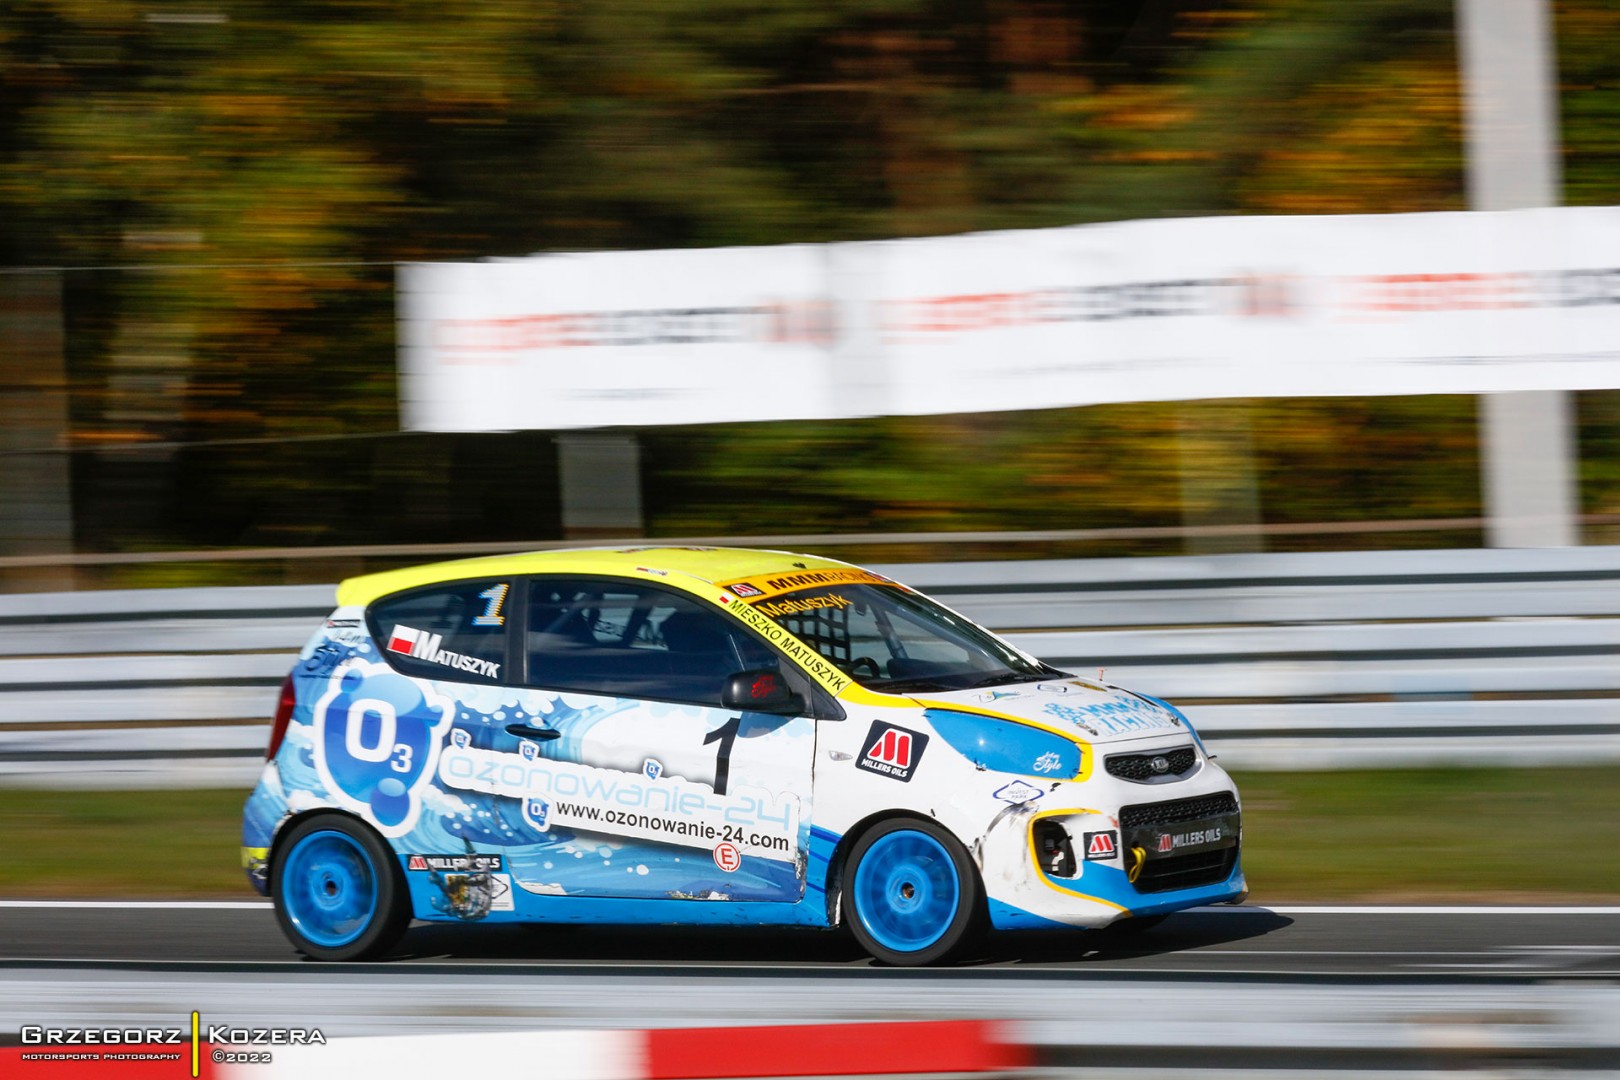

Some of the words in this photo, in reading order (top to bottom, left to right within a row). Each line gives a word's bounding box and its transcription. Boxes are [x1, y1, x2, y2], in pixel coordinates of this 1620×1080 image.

[471, 583, 510, 626] 1
[755, 592, 854, 618] Matuszyk
[728, 599, 782, 640] MIESZKO
[780, 637, 847, 691] MATUSZYK
[702, 717, 741, 796] 1
[861, 758, 892, 774] MILLERS
[891, 768, 908, 778] OILS
[449, 755, 791, 832] ozonowanie-24
[556, 801, 789, 851] www.ozonowanie-24.com
[1172, 831, 1205, 848] MILLERS
[1205, 828, 1221, 842] OILS
